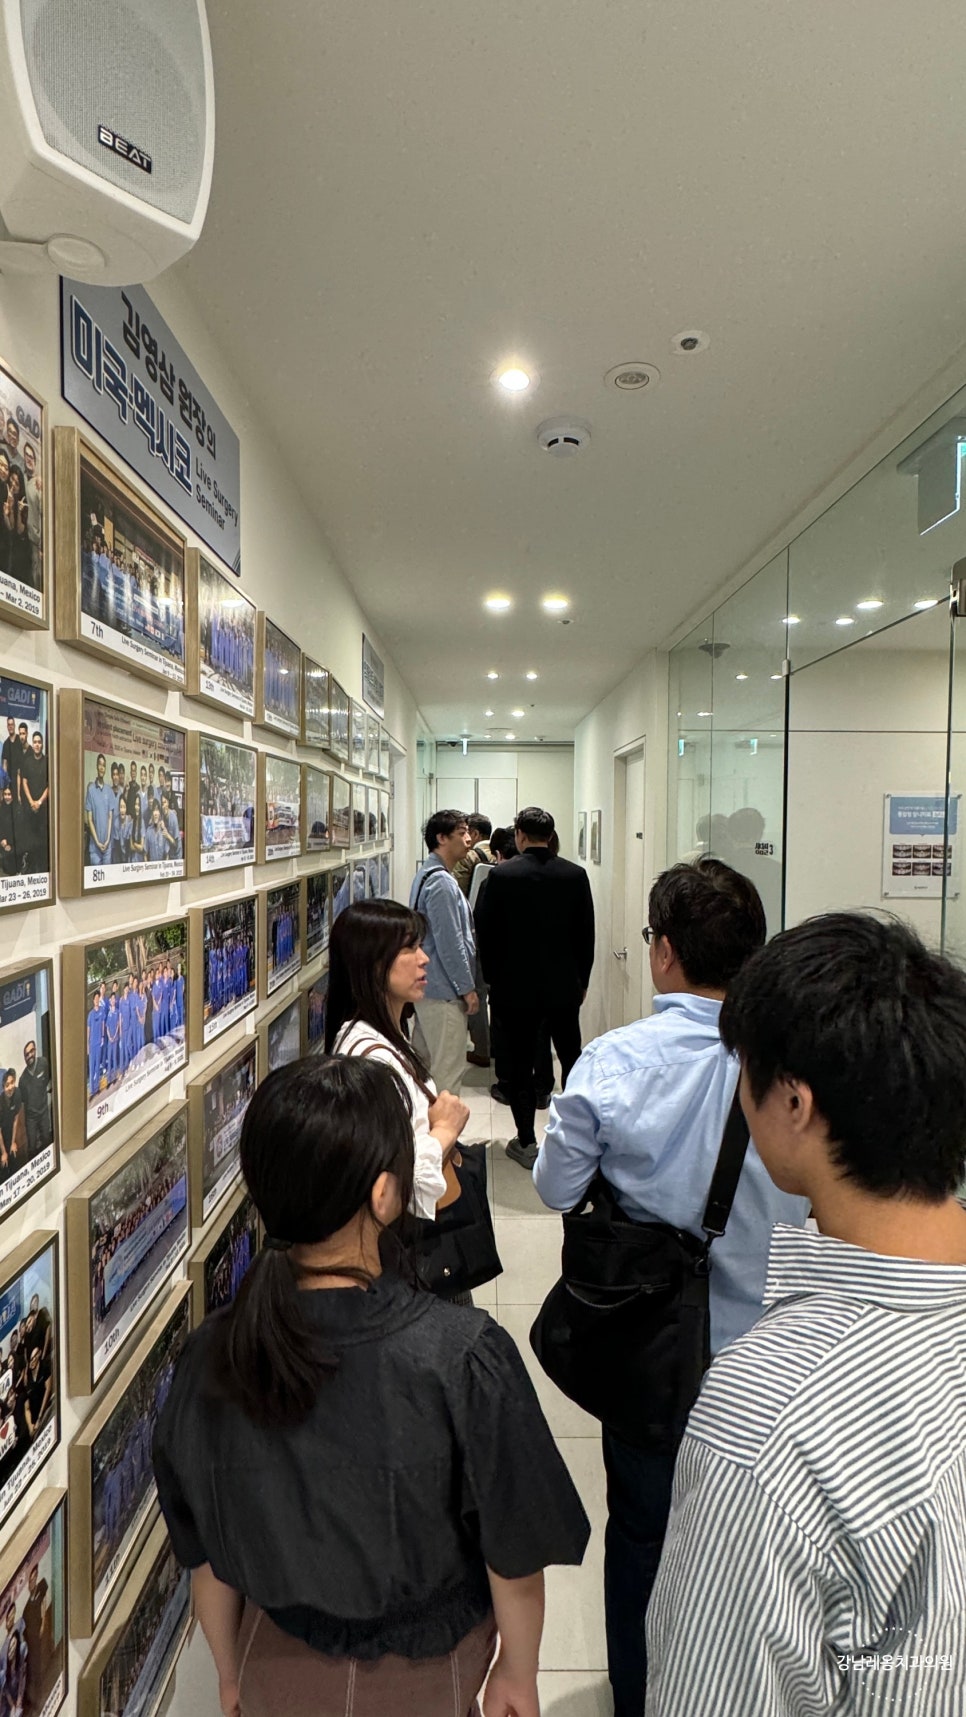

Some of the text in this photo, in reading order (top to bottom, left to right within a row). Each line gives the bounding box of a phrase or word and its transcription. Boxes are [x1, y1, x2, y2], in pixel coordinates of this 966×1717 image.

[99, 126, 151, 168] BEAT
[121, 290, 216, 460] 김영삼 원장의
[196, 457, 239, 527] Live Surgery
[196, 484, 226, 530] Seminar
[5, 591, 17, 605] Mar
[24, 601, 40, 615] 2019
[20, 584, 41, 603] Mexico
[90, 620, 104, 640] 7th
[1, 875, 48, 891] Tijuana, Mexico
[92, 869, 105, 882] 8th
[8, 892, 17, 902] 23
[32, 887, 47, 898] 2019
[96, 1101, 109, 1119] 9th
[5, 1168, 29, 1192] Tijuana,
[30, 1150, 51, 1171] Mexico
[13, 1186, 21, 1199] 17
[36, 1161, 51, 1179] 2019
